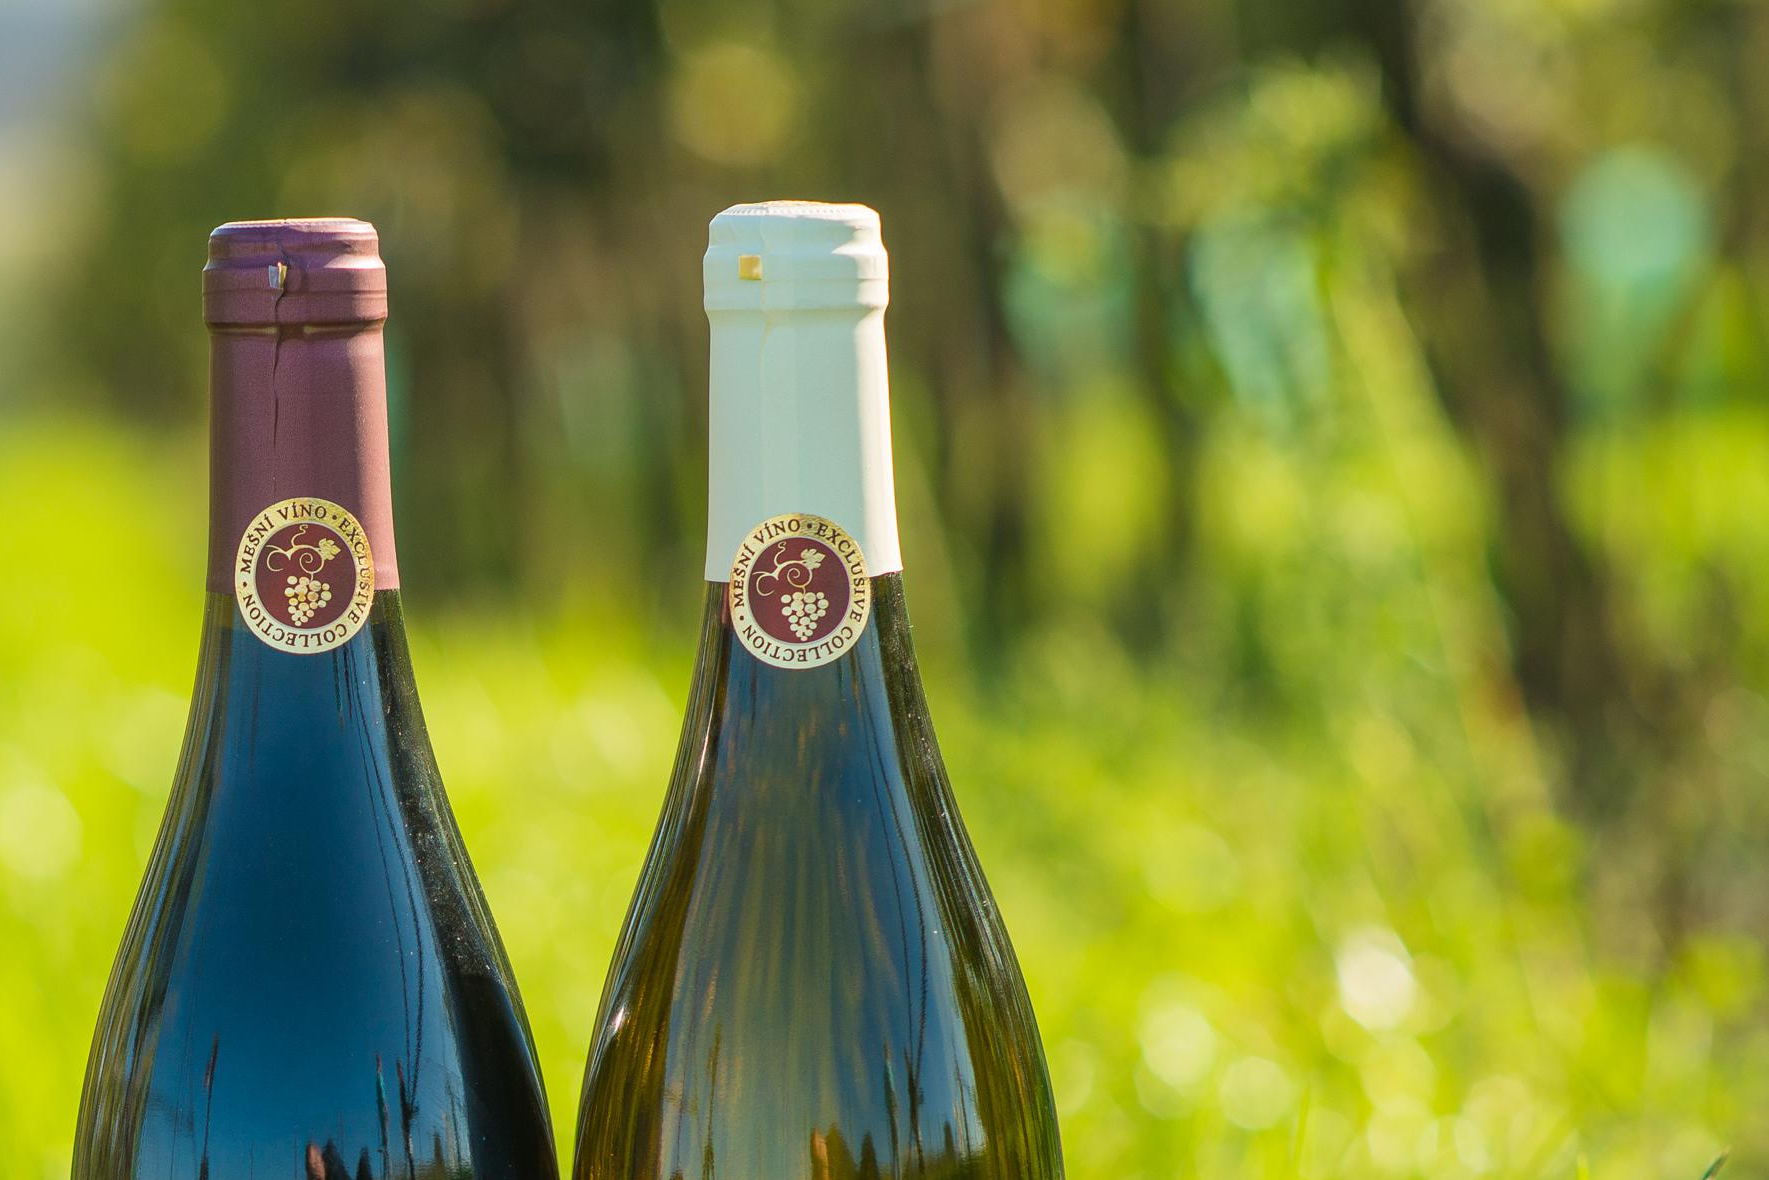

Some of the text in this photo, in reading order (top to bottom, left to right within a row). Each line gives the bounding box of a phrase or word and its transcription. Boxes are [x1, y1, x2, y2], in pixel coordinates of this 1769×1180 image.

[240, 502, 371, 647] MEŠNÍ VÍNO EXCLUSIVE COLLECTION
[734, 519, 865, 662] MEŠNÍ VÍNO EXCLUSIVE COLLECTION
